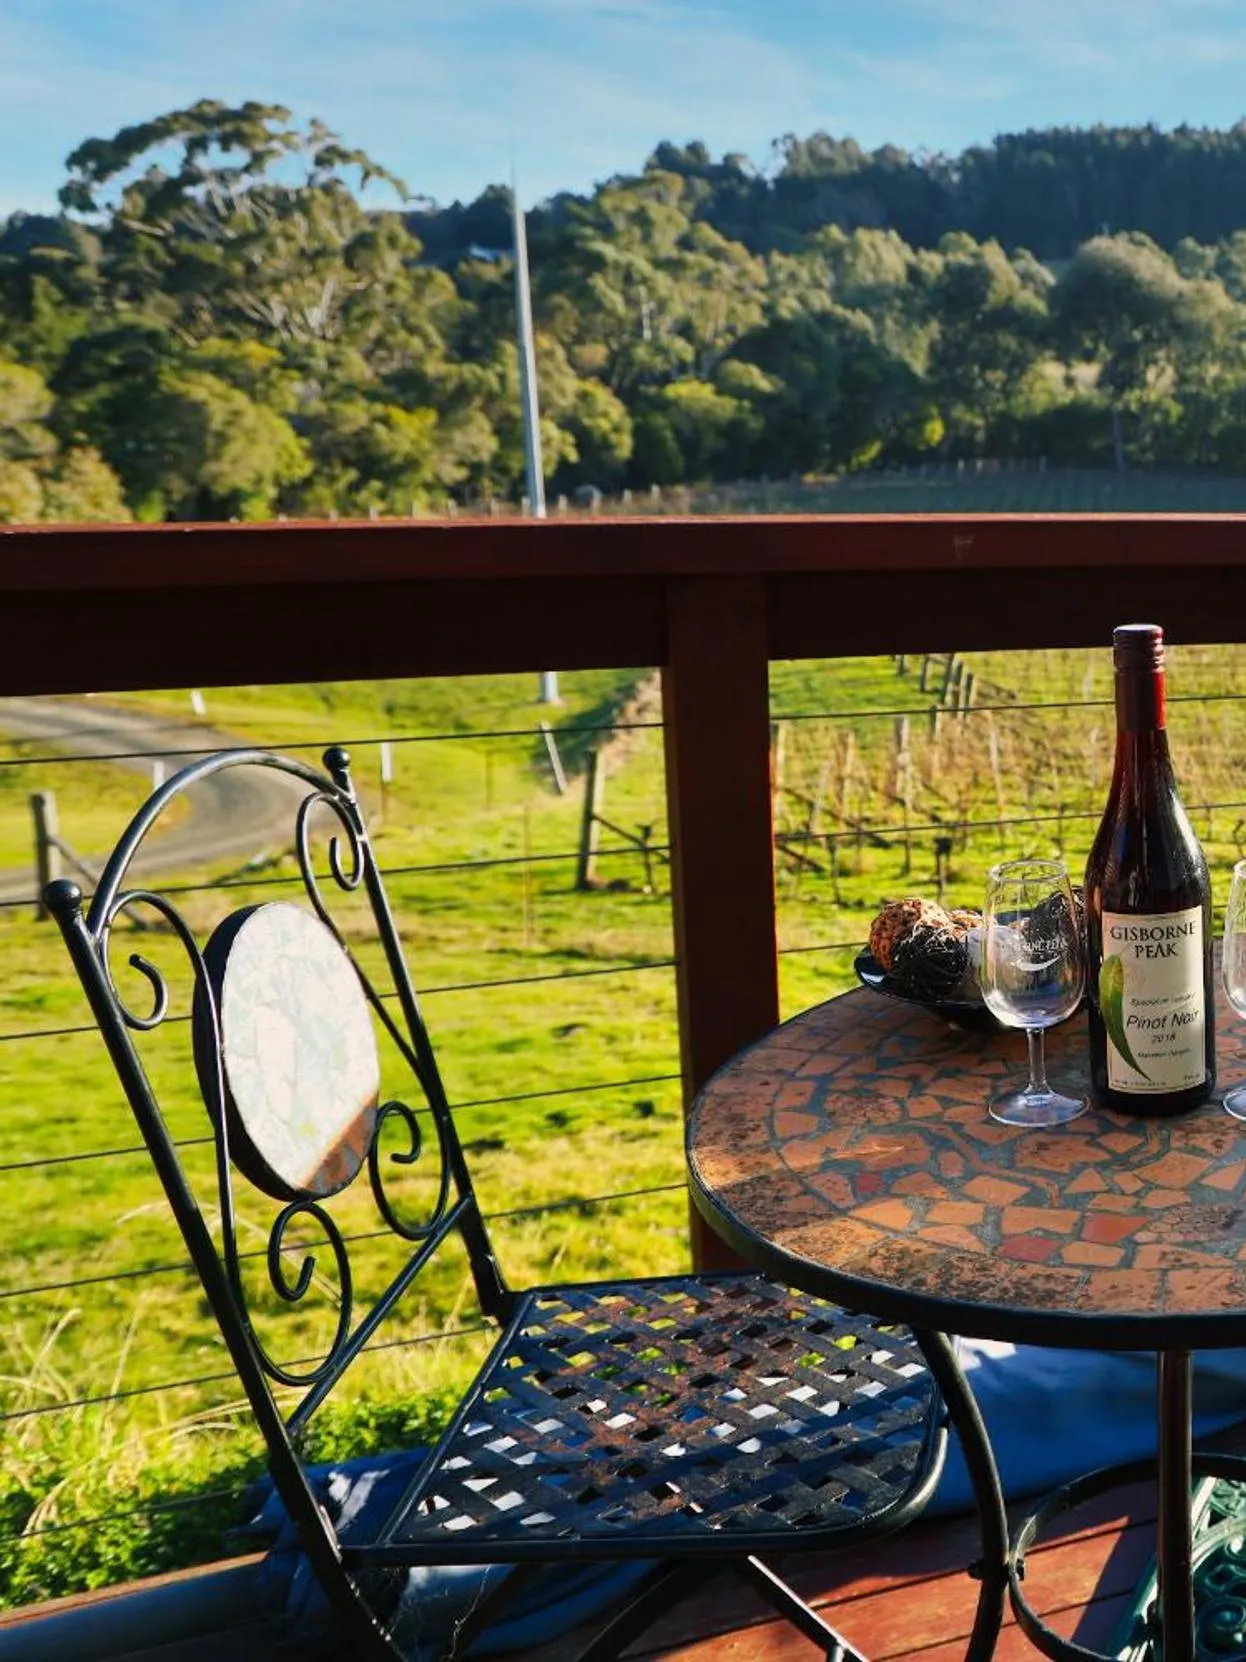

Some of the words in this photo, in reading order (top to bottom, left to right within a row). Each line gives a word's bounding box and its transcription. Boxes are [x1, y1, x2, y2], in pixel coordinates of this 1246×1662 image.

[1110, 921, 1196, 942] GISBORNE
[1135, 942, 1179, 959] PEAK
[1126, 1014, 1168, 1029] Pinot
[1171, 1008, 1199, 1027] Noir
